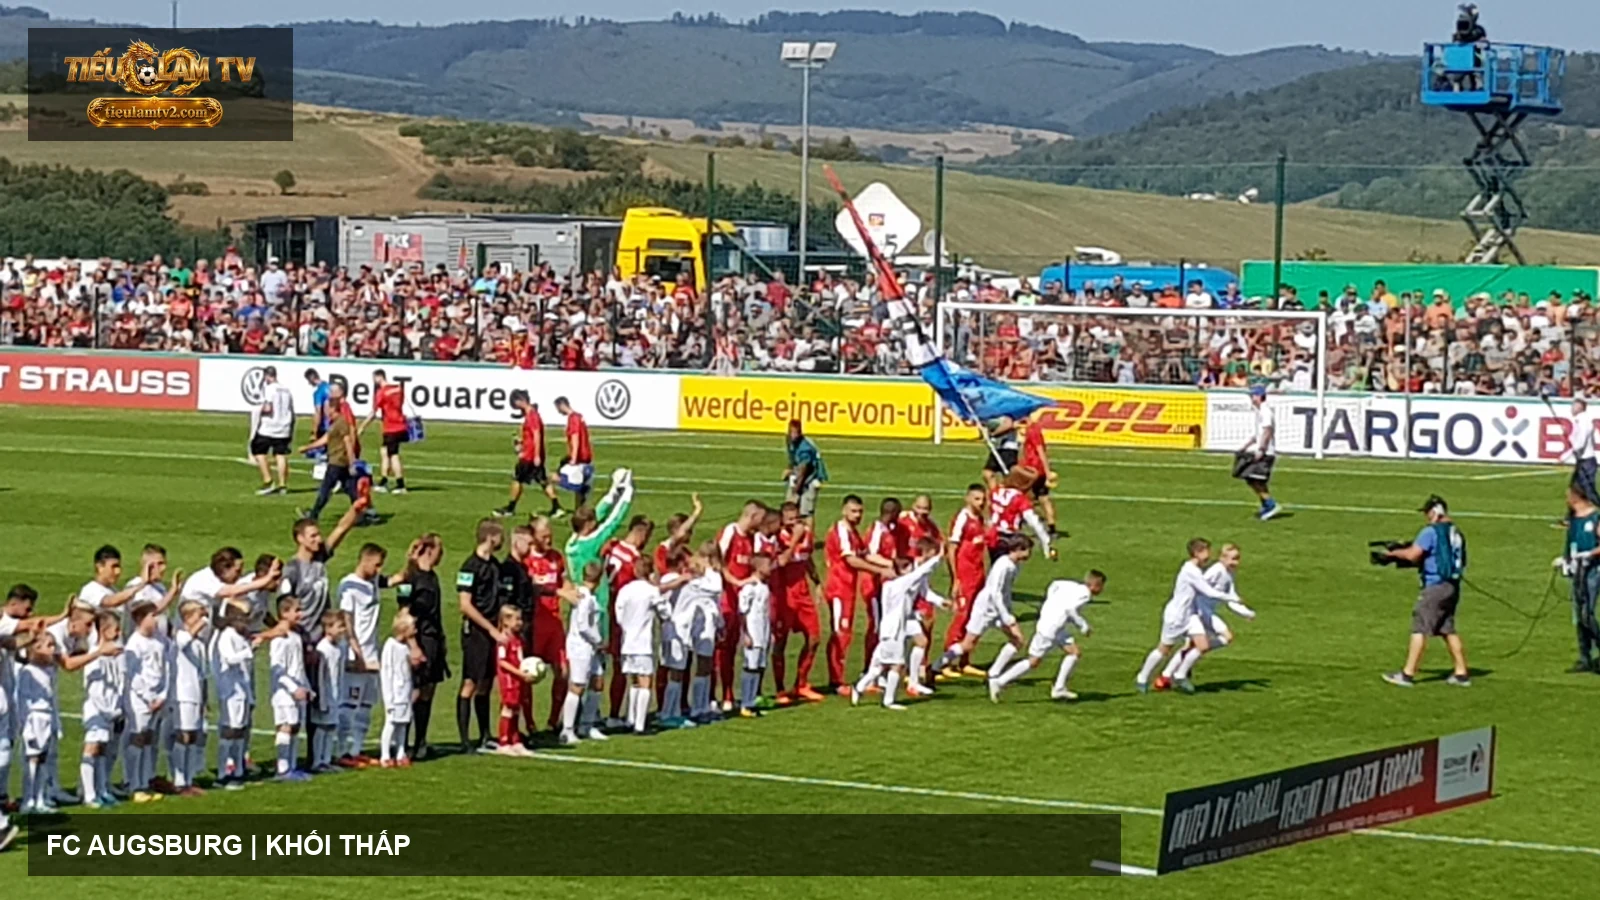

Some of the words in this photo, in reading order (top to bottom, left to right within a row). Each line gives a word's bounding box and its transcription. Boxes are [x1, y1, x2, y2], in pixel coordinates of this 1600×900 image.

[19, 365, 191, 396] STRAUSS
[329, 373, 385, 405] De
[1036, 399, 1172, 434] DHL
[1293, 406, 1483, 456] TARGO
